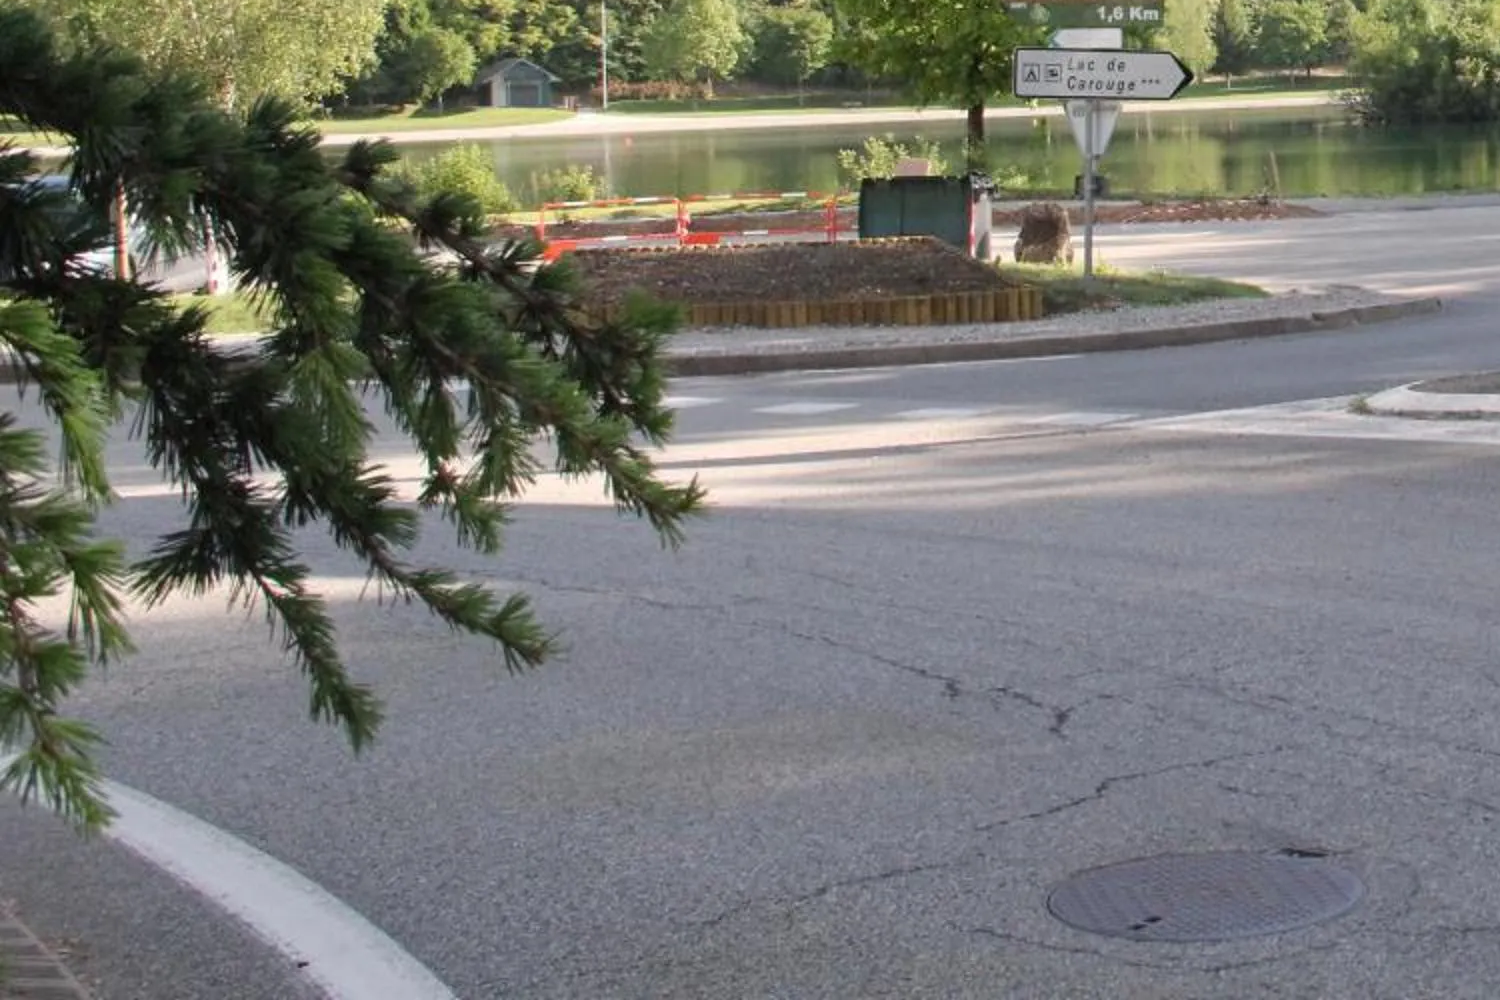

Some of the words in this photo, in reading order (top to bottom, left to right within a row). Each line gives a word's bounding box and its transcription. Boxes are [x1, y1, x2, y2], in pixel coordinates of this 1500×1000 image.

[1096, 5, 1124, 23] 1,6
[1129, 5, 1160, 22] Km
[1106, 56, 1127, 73] de
[1066, 75, 1138, 96] Carouge
